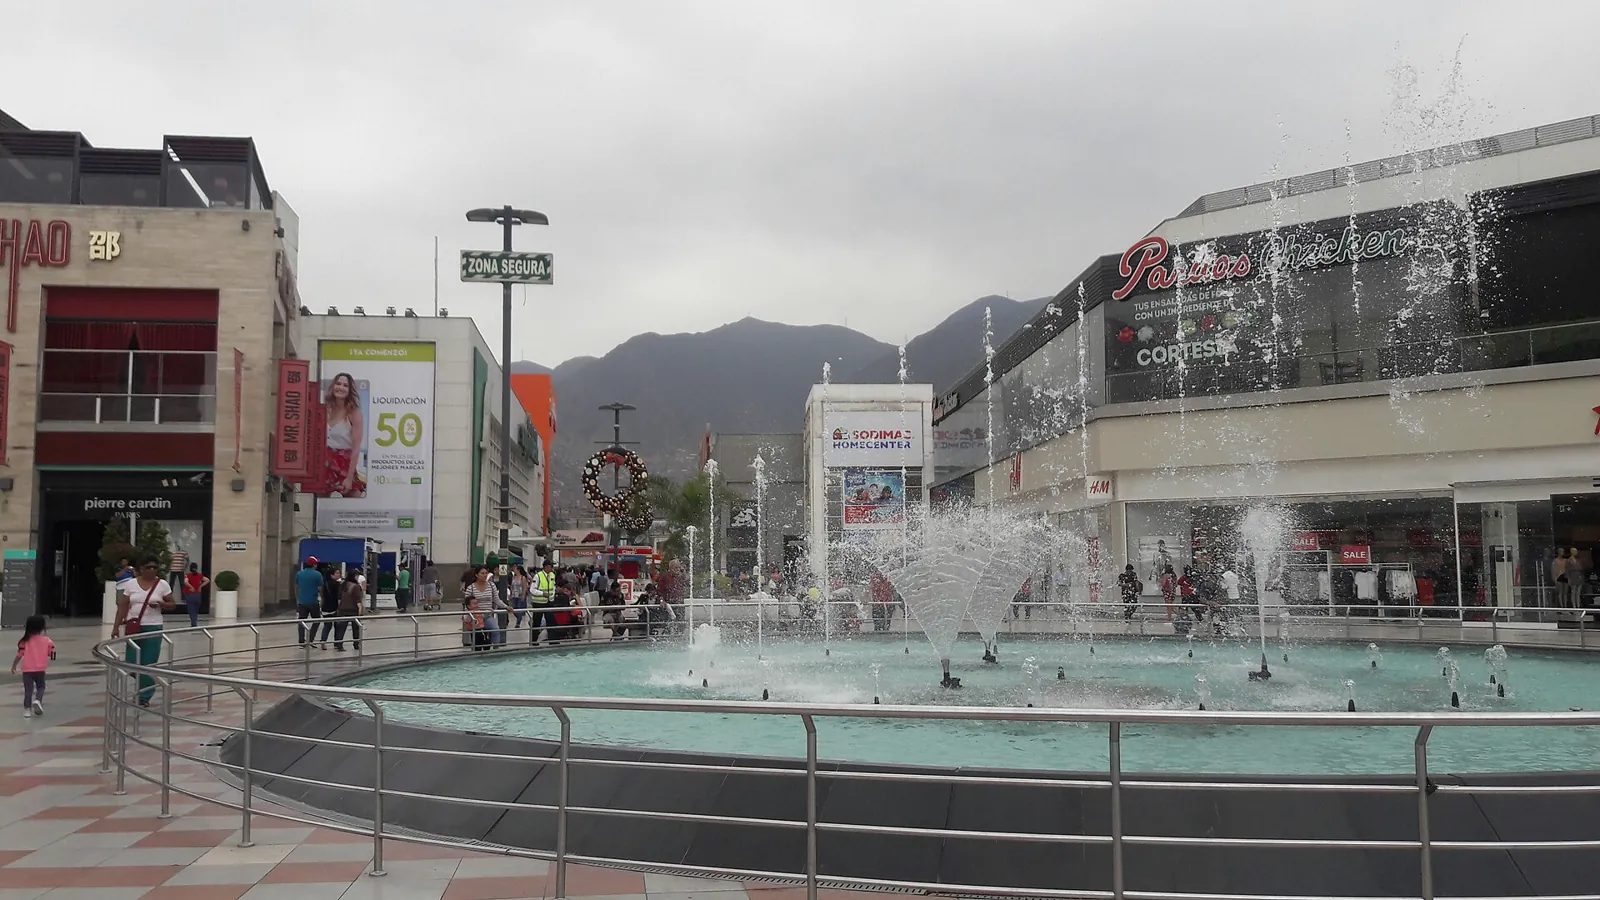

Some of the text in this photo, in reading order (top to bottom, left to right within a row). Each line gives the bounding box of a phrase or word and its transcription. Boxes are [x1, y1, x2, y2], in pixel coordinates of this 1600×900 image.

[1260, 227, 1409, 271] Chicken
[468, 257, 546, 275] ZONA SEGURA
[1134, 302, 1149, 311] TUS
[1199, 291, 1210, 301] DE
[1134, 310, 1153, 321] CON
[1155, 309, 1166, 318] UN
[1167, 299, 1222, 315] INGREDIENTE
[372, 396, 427, 405] LIQUIDACIÓN
[283, 391, 301, 443] MR. SHAO
[375, 412, 423, 447] 50
[852, 430, 912, 440] SODIMAC
[832, 441, 911, 449] HOMECENTER
[84, 496, 171, 510] pierre cardin
[114, 511, 141, 519] PARS
[1294, 538, 1315, 546] SALE
[1343, 551, 1366, 559] SALE
